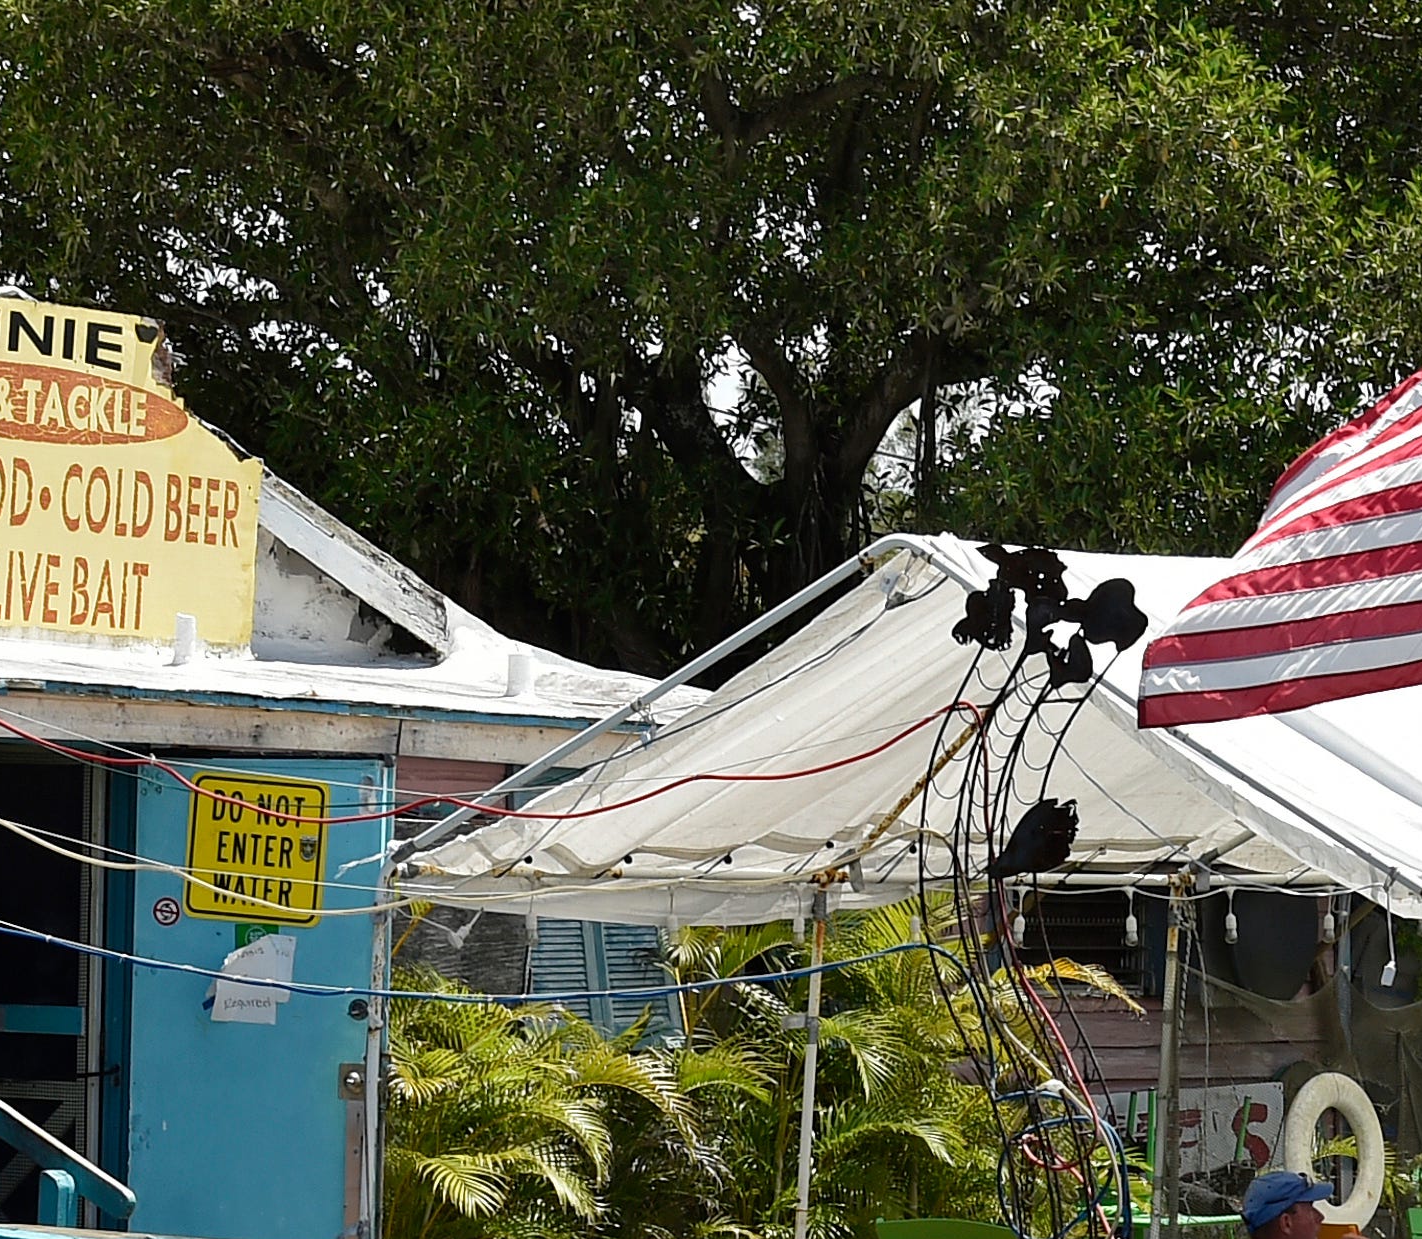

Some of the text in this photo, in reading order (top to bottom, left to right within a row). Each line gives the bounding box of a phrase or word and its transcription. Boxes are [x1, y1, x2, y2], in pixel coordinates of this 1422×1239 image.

[23, 377, 148, 438] TACKLE
[62, 463, 154, 539] COLD
[165, 474, 240, 548] BEER
[69, 555, 149, 630] BAIT
[212, 789, 306, 828] DO NOT
[217, 831, 294, 869] ENTER
[213, 873, 293, 909] WATER
